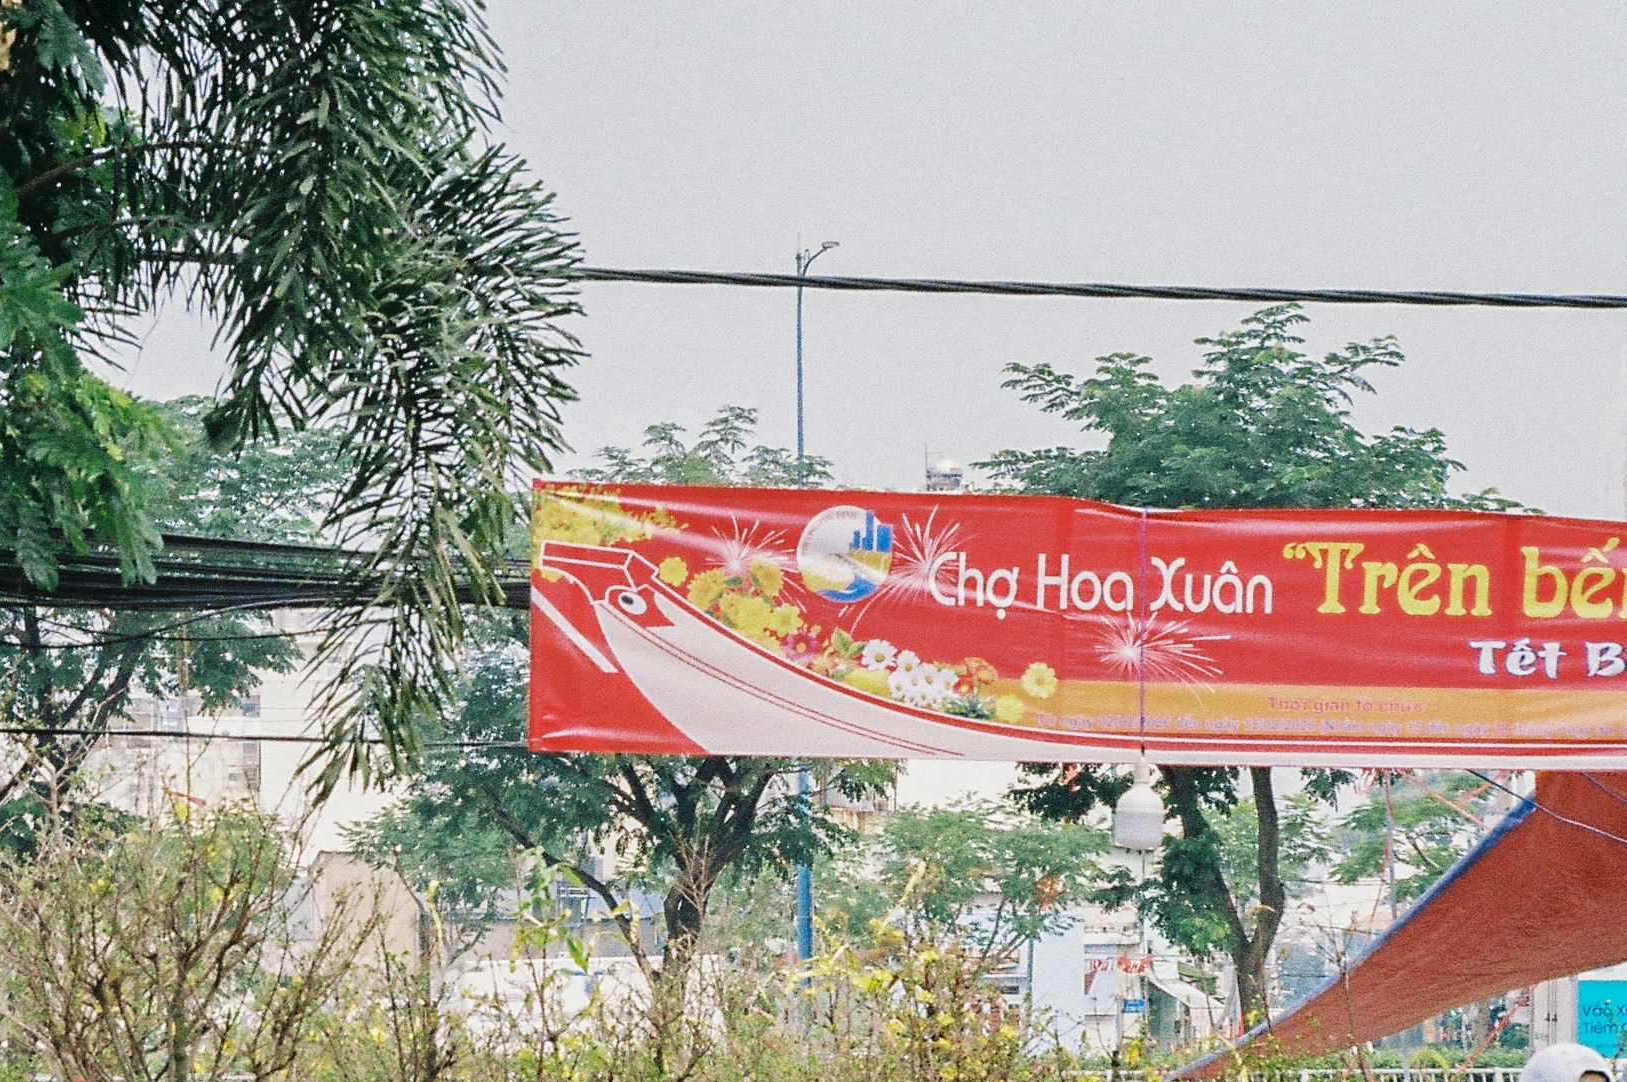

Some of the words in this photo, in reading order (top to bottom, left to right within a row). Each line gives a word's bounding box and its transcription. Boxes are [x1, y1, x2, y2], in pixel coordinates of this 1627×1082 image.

[929, 551, 1020, 620] Chợ
[1037, 553, 1134, 612] Hoa
[1149, 556, 1273, 615] Xuân
[1520, 537, 1627, 619] bế
[1469, 637, 1567, 680] Tết
